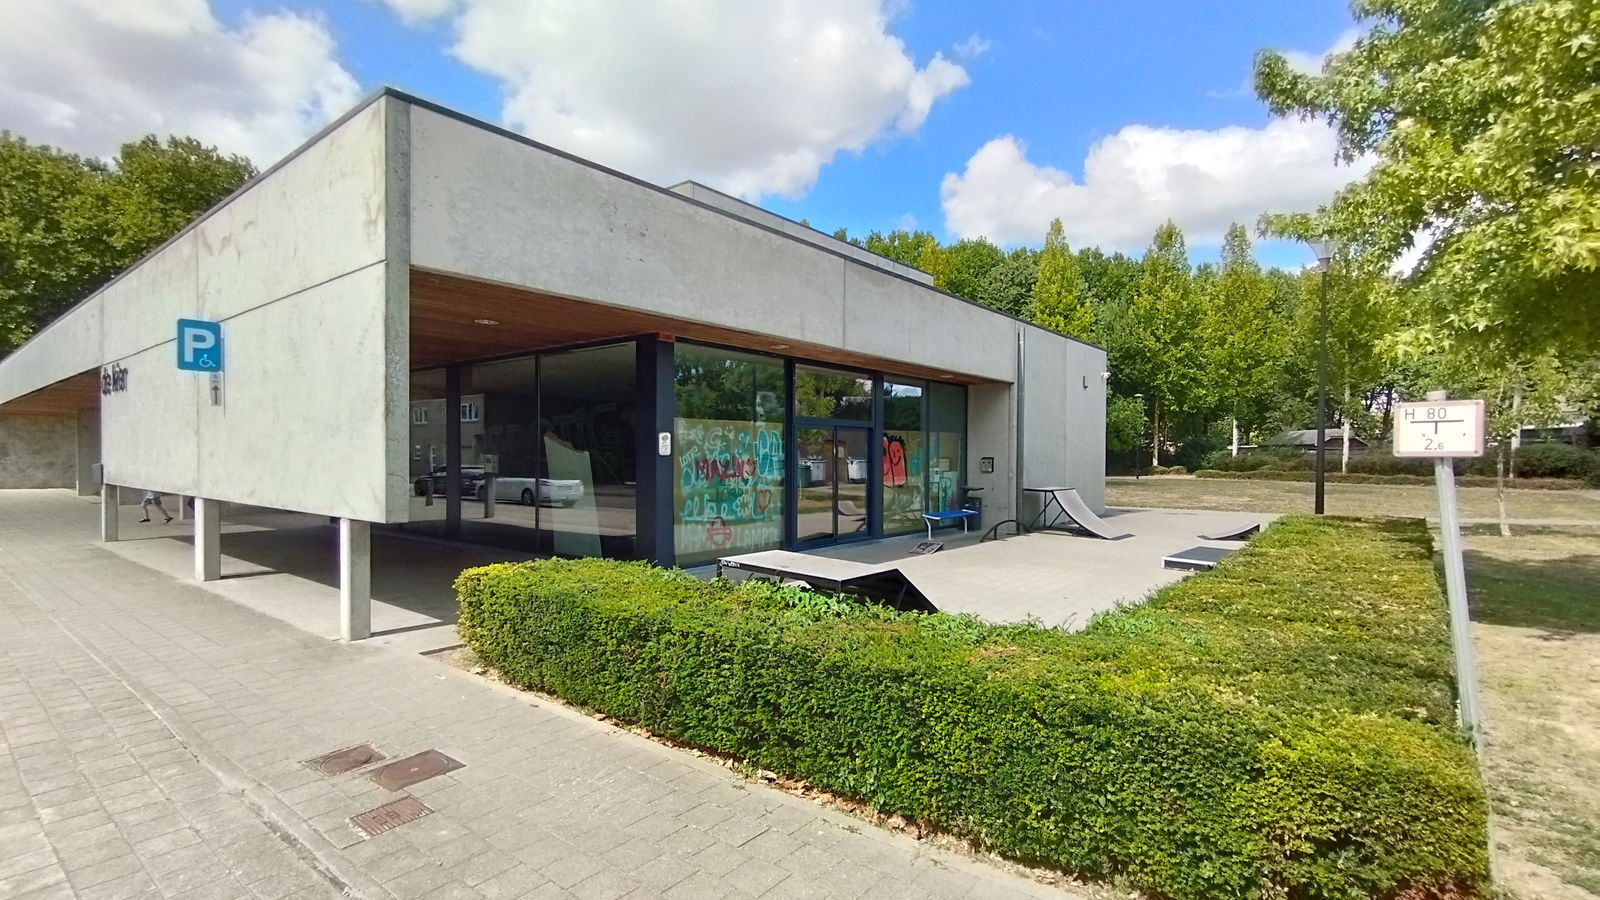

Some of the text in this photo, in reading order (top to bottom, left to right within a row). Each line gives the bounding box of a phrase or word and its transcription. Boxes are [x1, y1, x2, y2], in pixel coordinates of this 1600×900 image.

[184, 327, 215, 363] P
[1404, 407, 1447, 420] H 80
